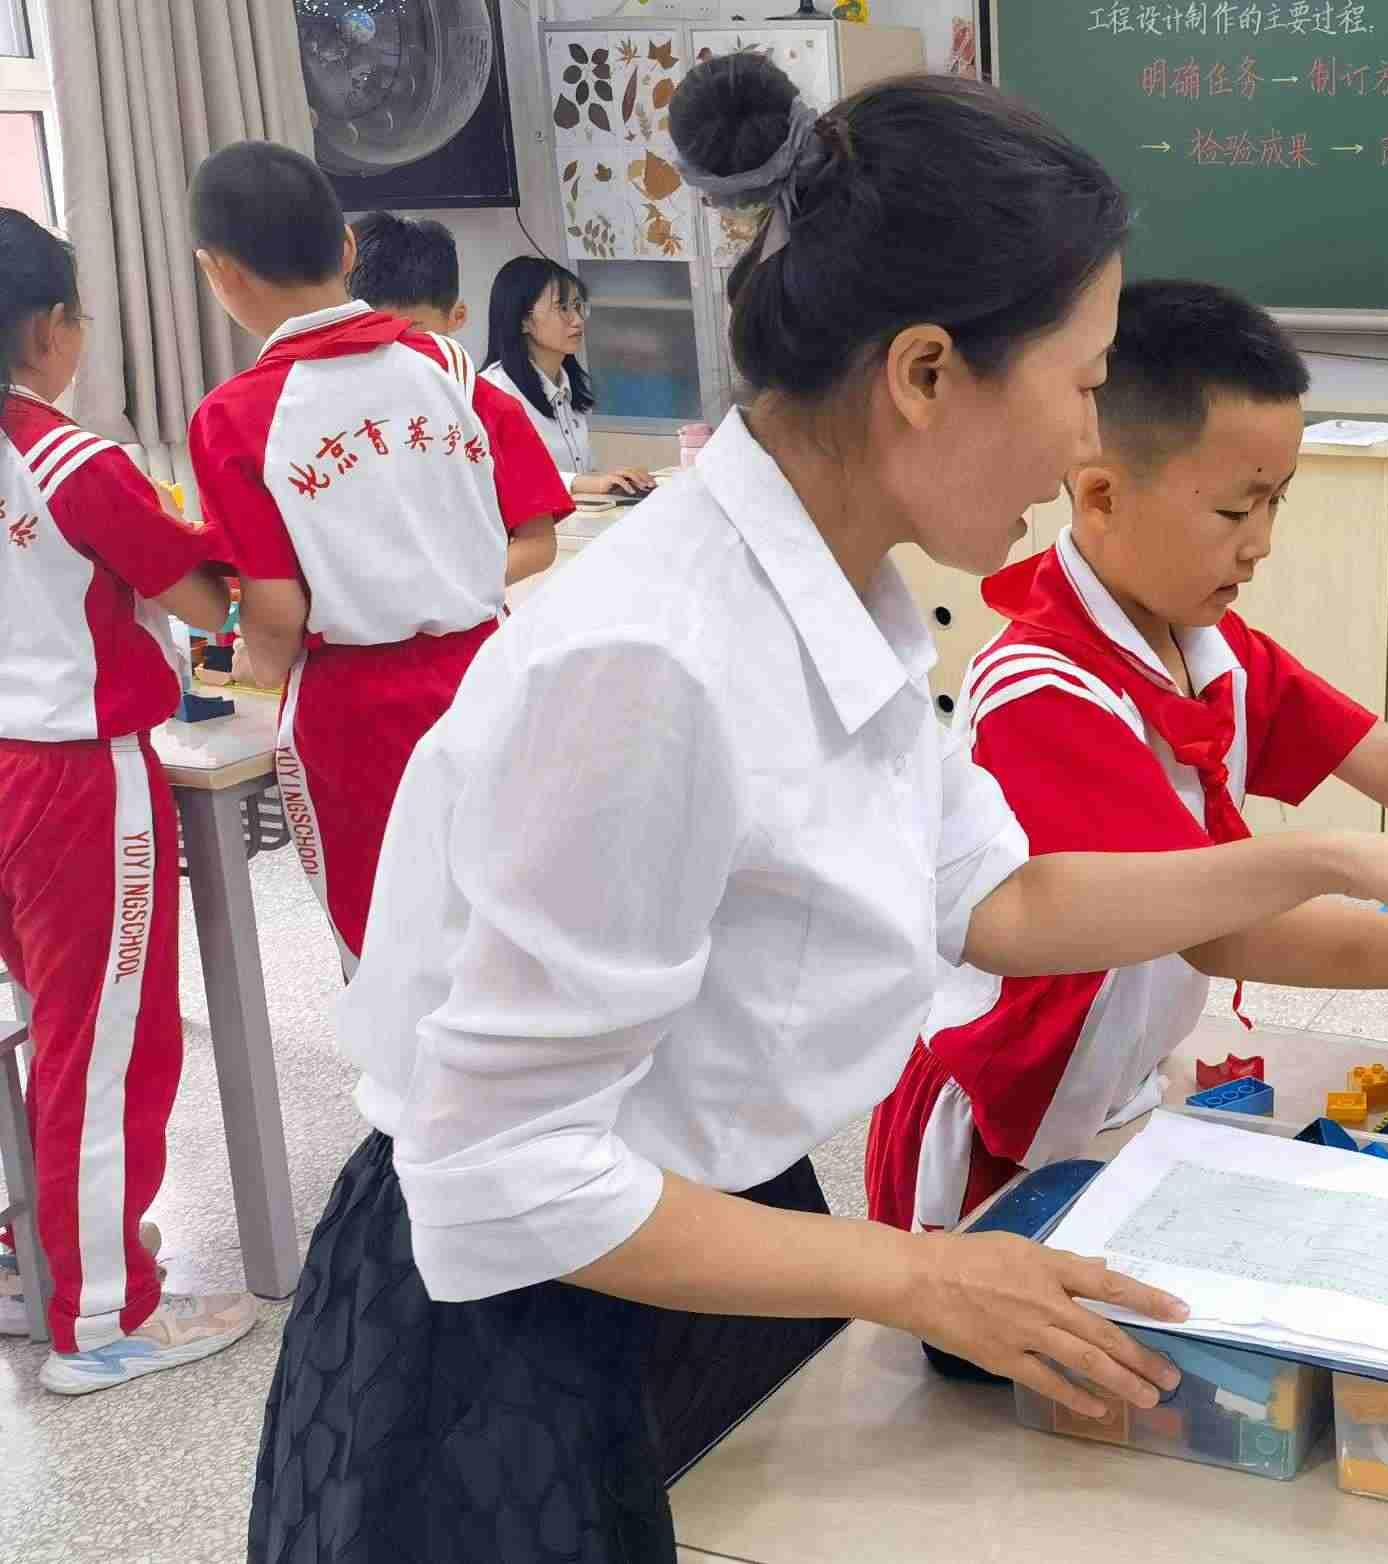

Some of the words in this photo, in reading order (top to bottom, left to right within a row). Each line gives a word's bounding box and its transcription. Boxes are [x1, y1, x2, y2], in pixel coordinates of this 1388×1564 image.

[1141, 56, 1265, 100] 明确任务
[1189, 127, 1316, 170] 检验成果
